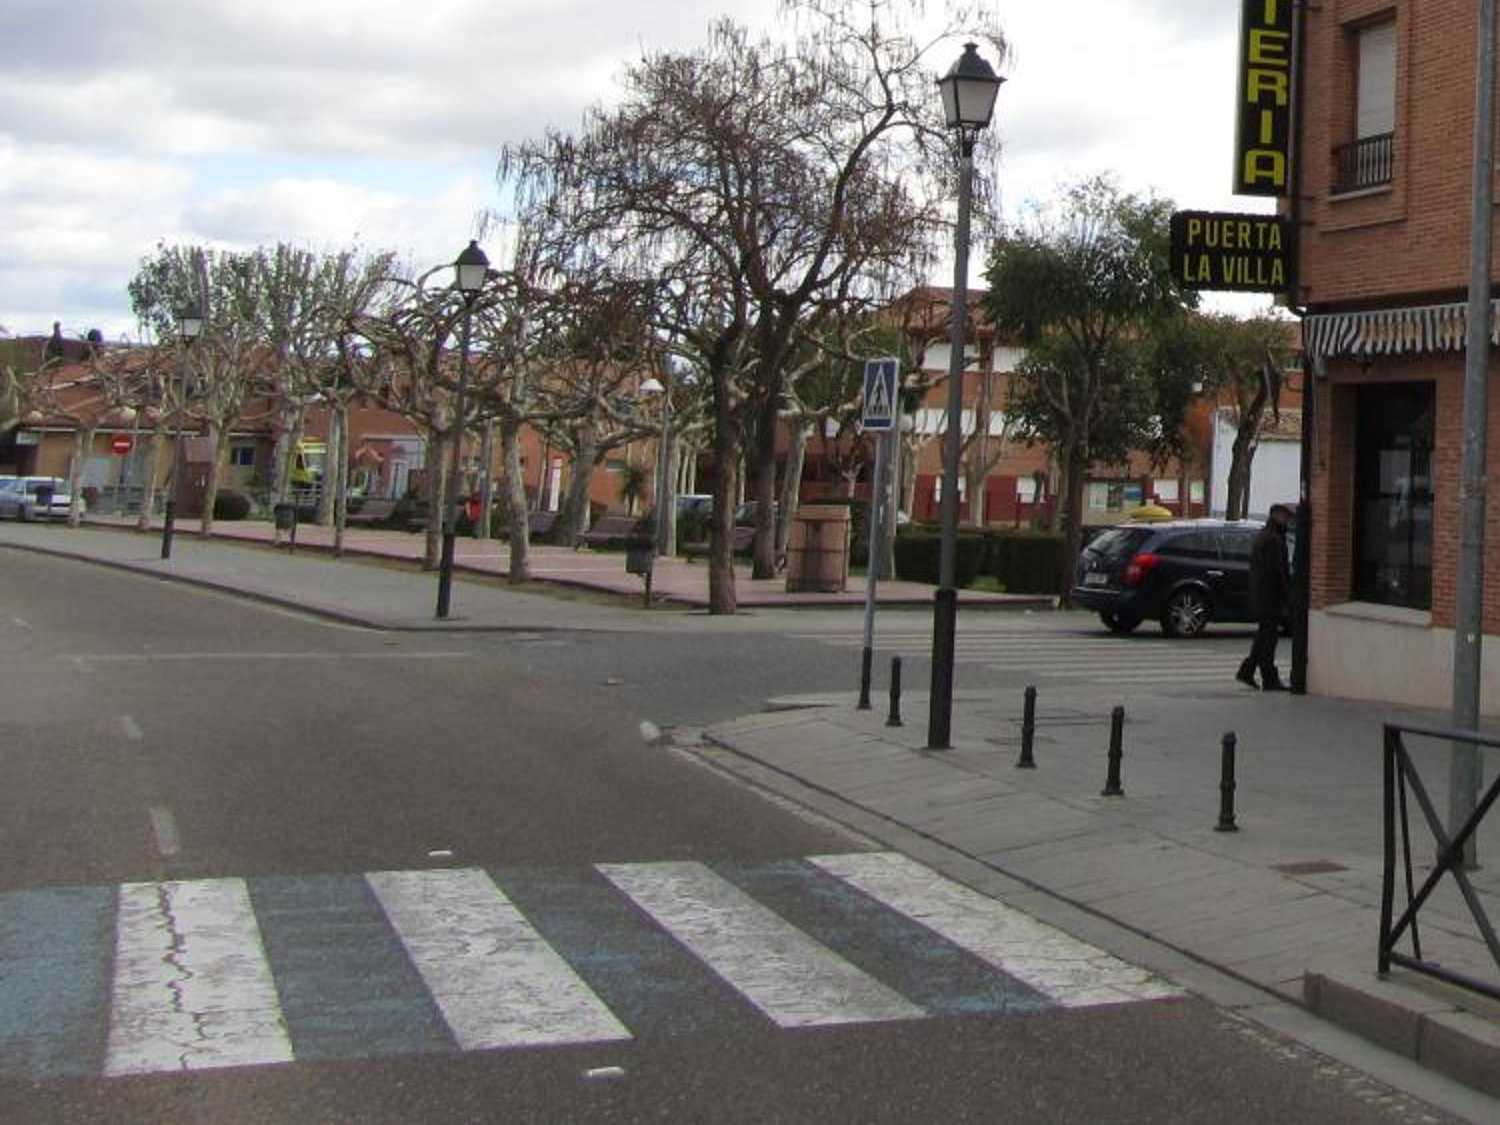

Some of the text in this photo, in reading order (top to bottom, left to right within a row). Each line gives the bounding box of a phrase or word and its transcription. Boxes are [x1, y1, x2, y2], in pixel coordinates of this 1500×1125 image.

[1188, 218, 1281, 250] PUERTA
[1184, 253, 1284, 285] LA VILLA
